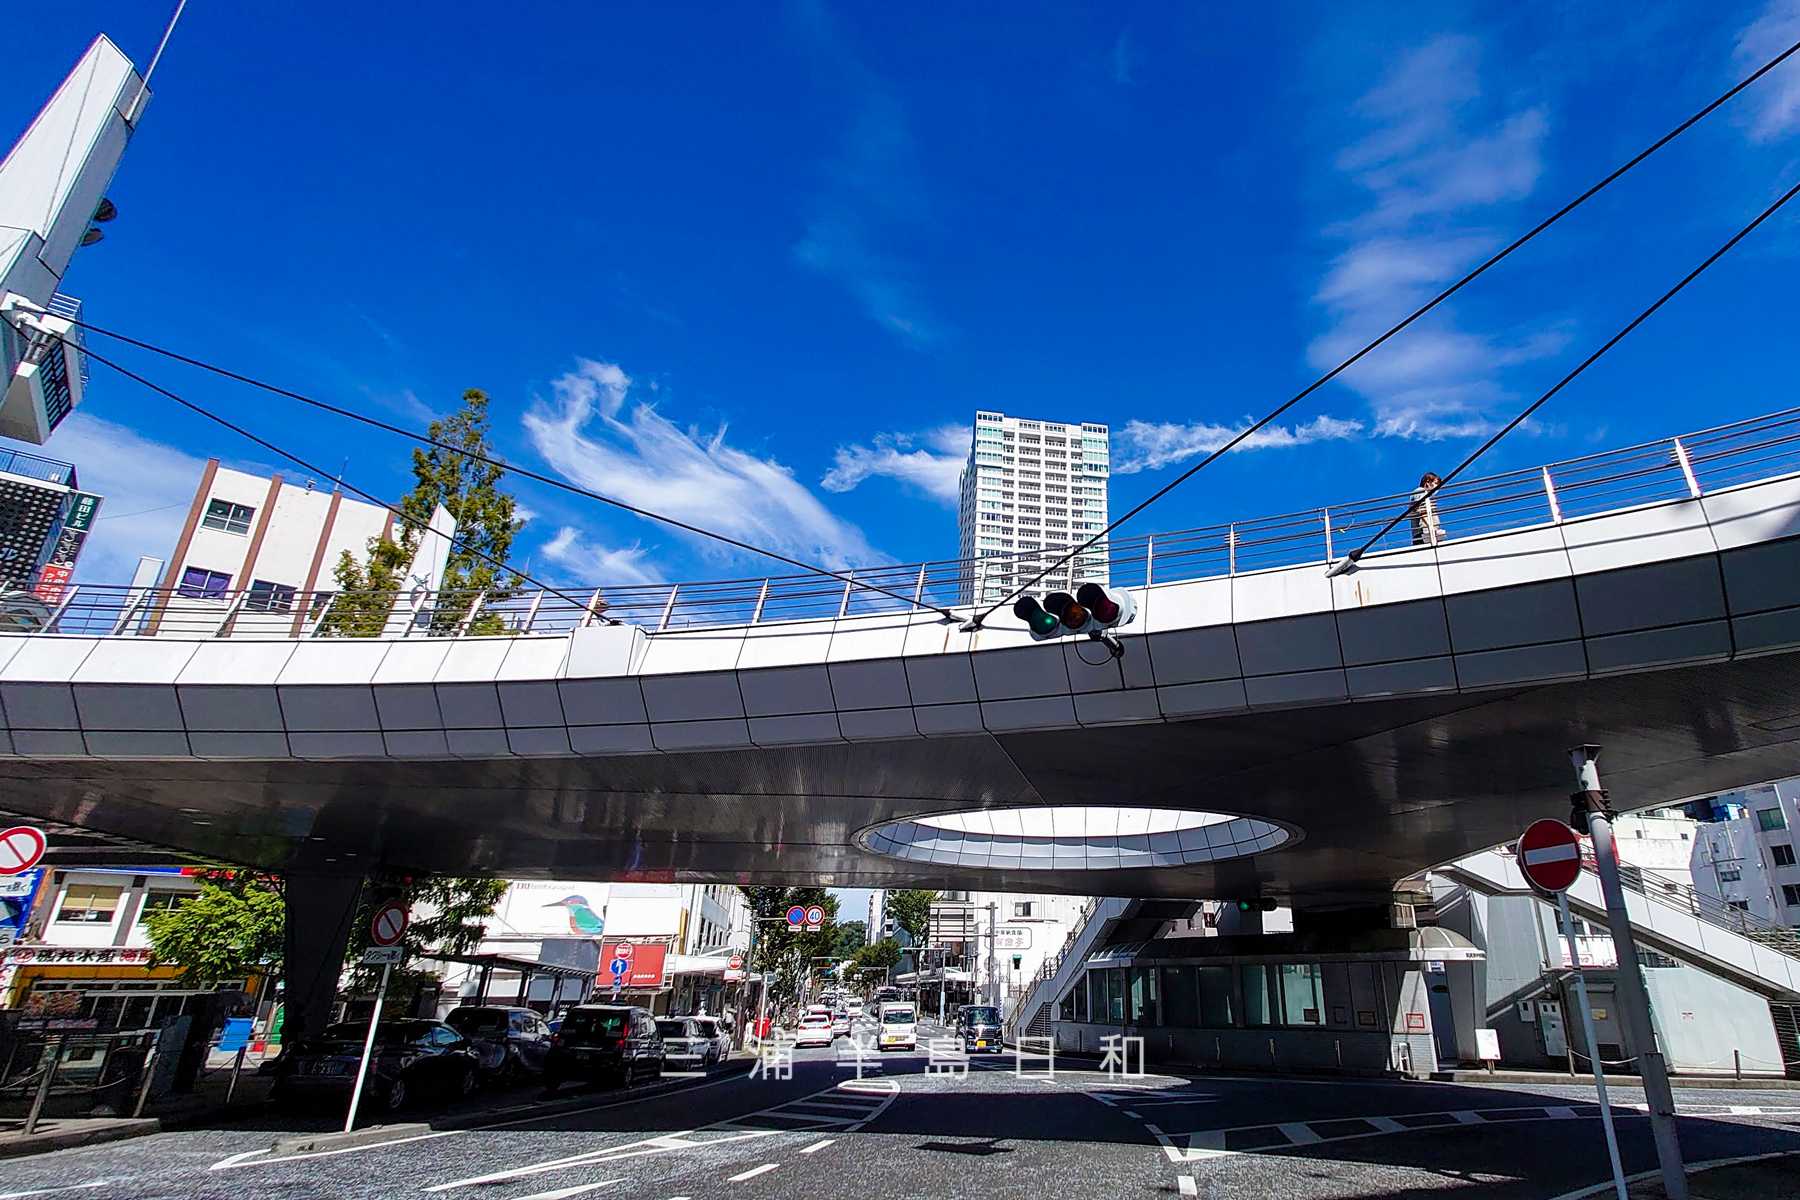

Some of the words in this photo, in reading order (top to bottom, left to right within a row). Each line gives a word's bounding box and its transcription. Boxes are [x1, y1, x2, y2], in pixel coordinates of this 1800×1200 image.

[72, 496, 95, 528] 藤田ビル
[809, 911, 821, 920] 40
